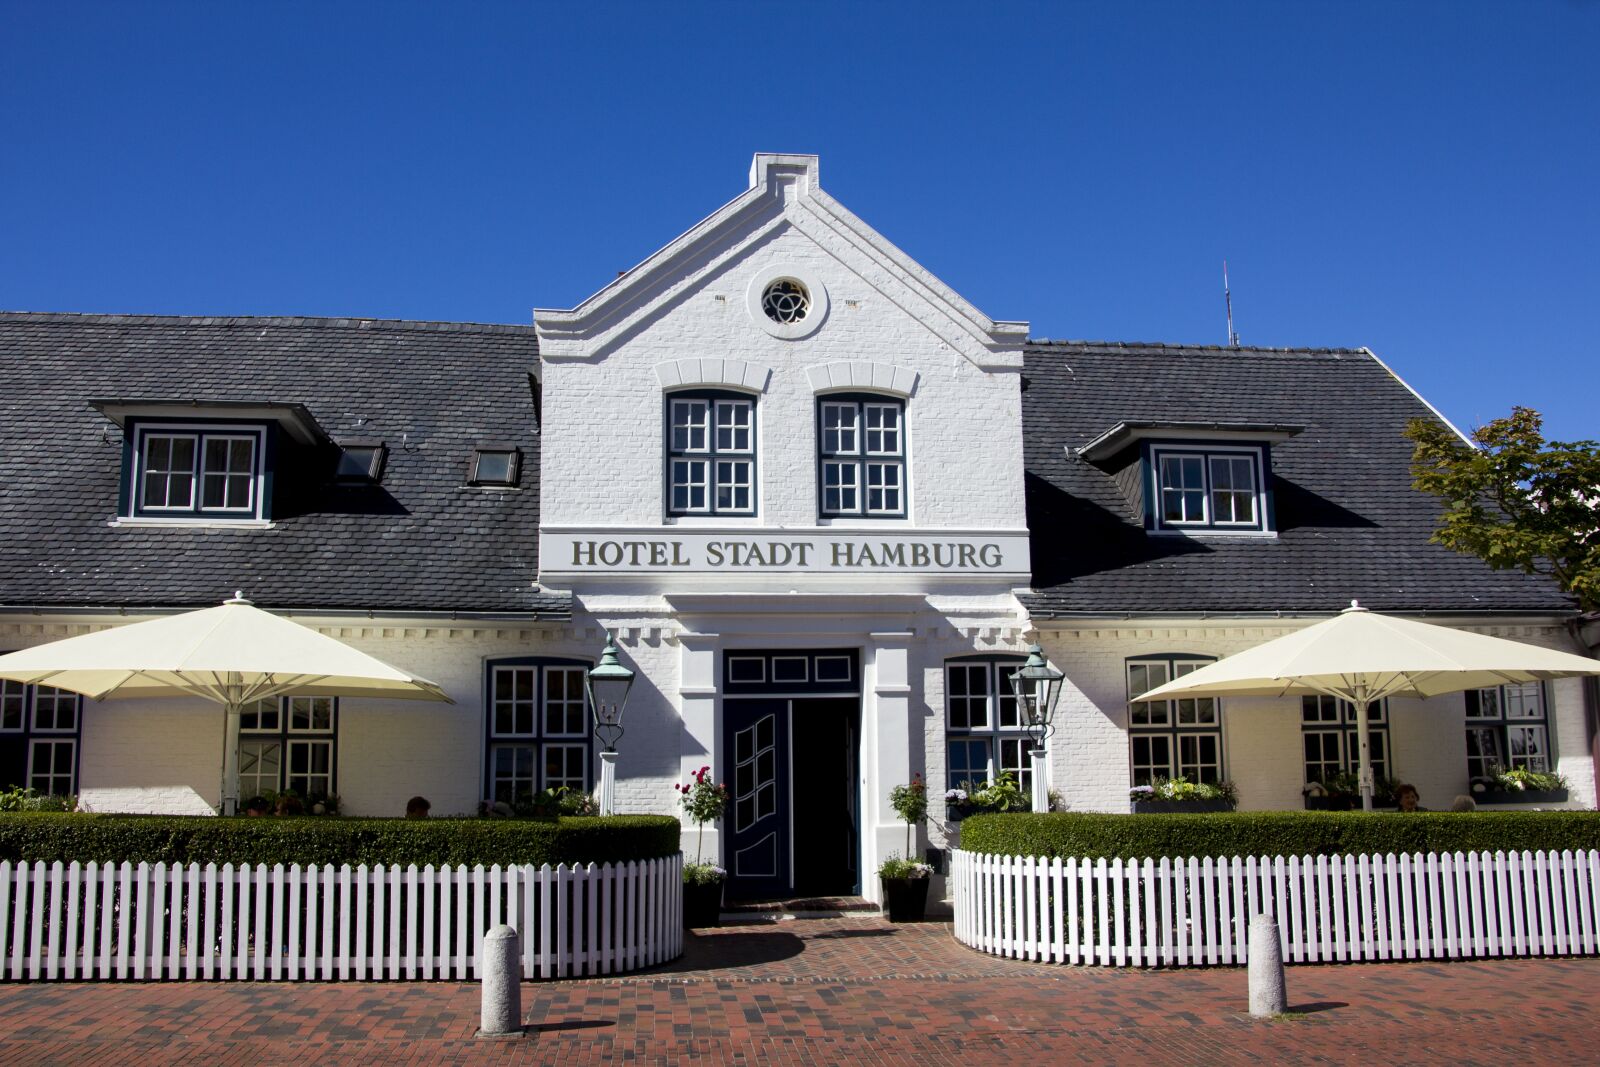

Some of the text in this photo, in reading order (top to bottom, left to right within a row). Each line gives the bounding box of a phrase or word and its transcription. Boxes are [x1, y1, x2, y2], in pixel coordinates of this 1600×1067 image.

[571, 541, 1003, 568] HOTEL STADT HAMBURG
